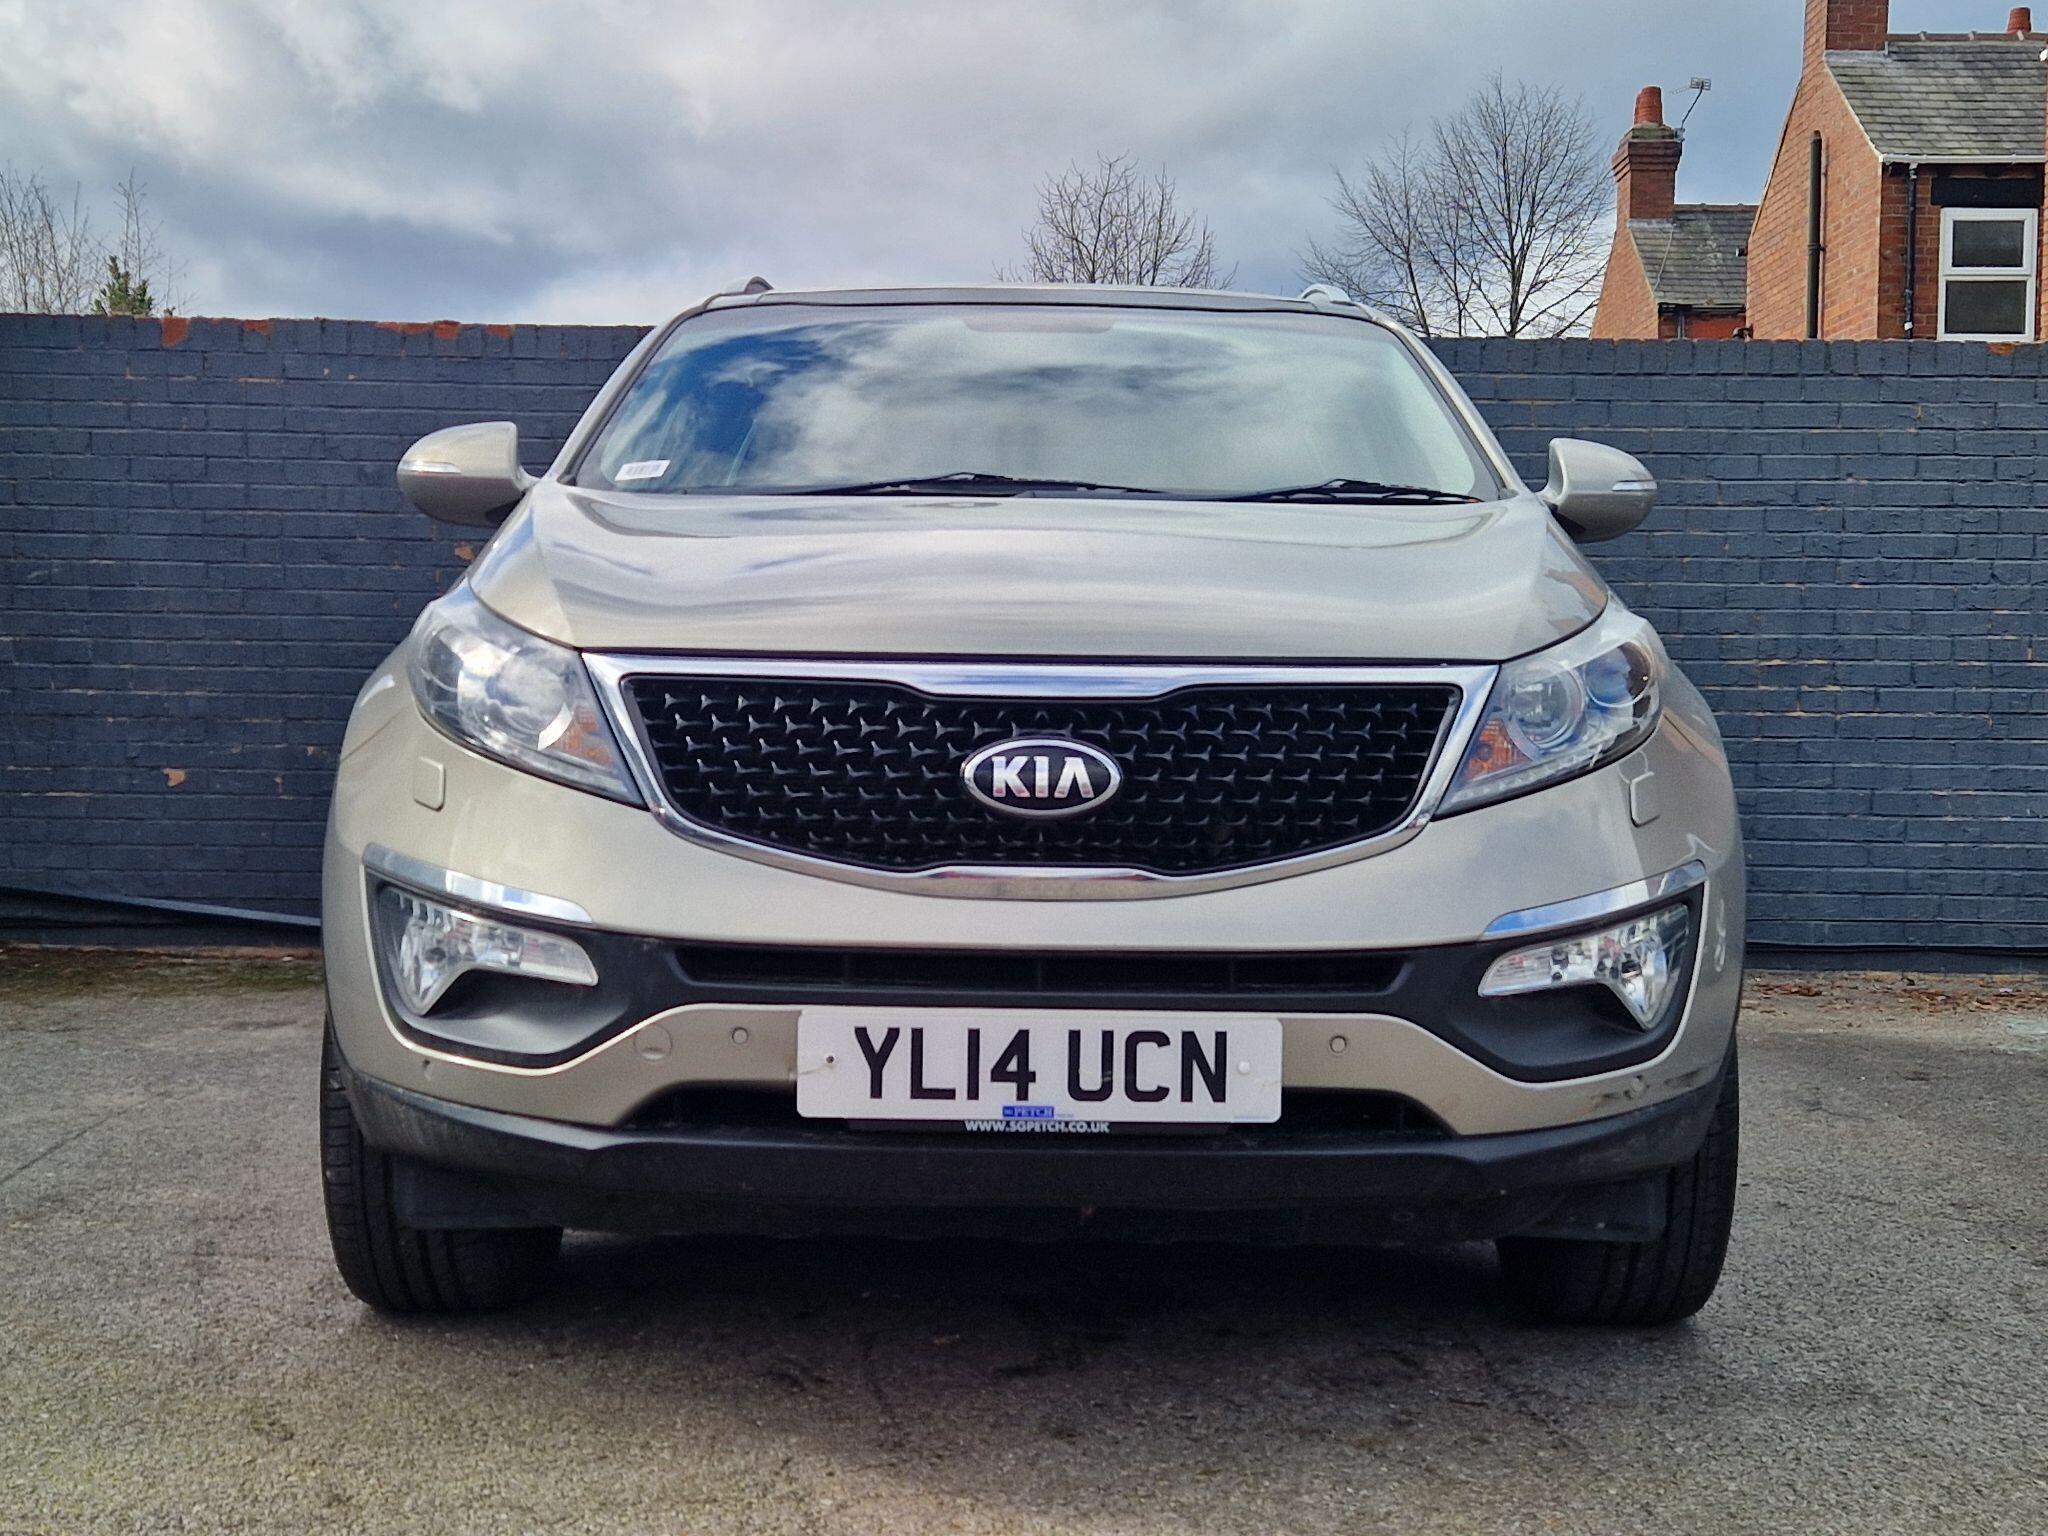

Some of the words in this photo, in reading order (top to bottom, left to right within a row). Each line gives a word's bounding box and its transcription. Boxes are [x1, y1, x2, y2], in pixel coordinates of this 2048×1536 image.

[992, 756, 1094, 798] KIA
[854, 1027, 1036, 1102] YL14
[1068, 1029, 1228, 1103] UCN
